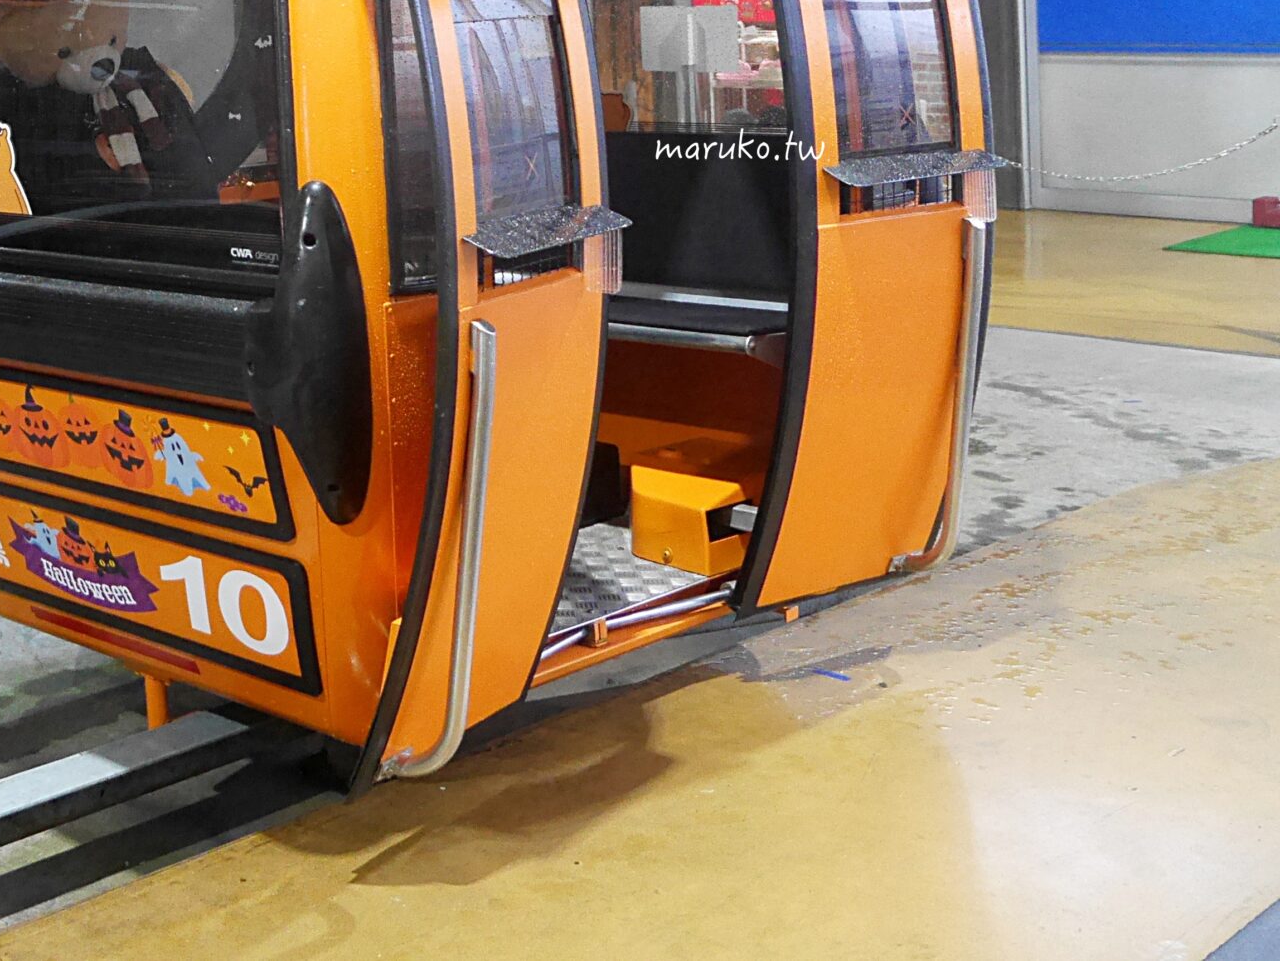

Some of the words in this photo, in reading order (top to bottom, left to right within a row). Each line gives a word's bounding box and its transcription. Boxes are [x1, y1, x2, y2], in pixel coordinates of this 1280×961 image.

[230, 247, 253, 259] CWA
[255, 250, 280, 263] design
[40, 557, 137, 606] Halloween
[159, 553, 289, 656] 10
